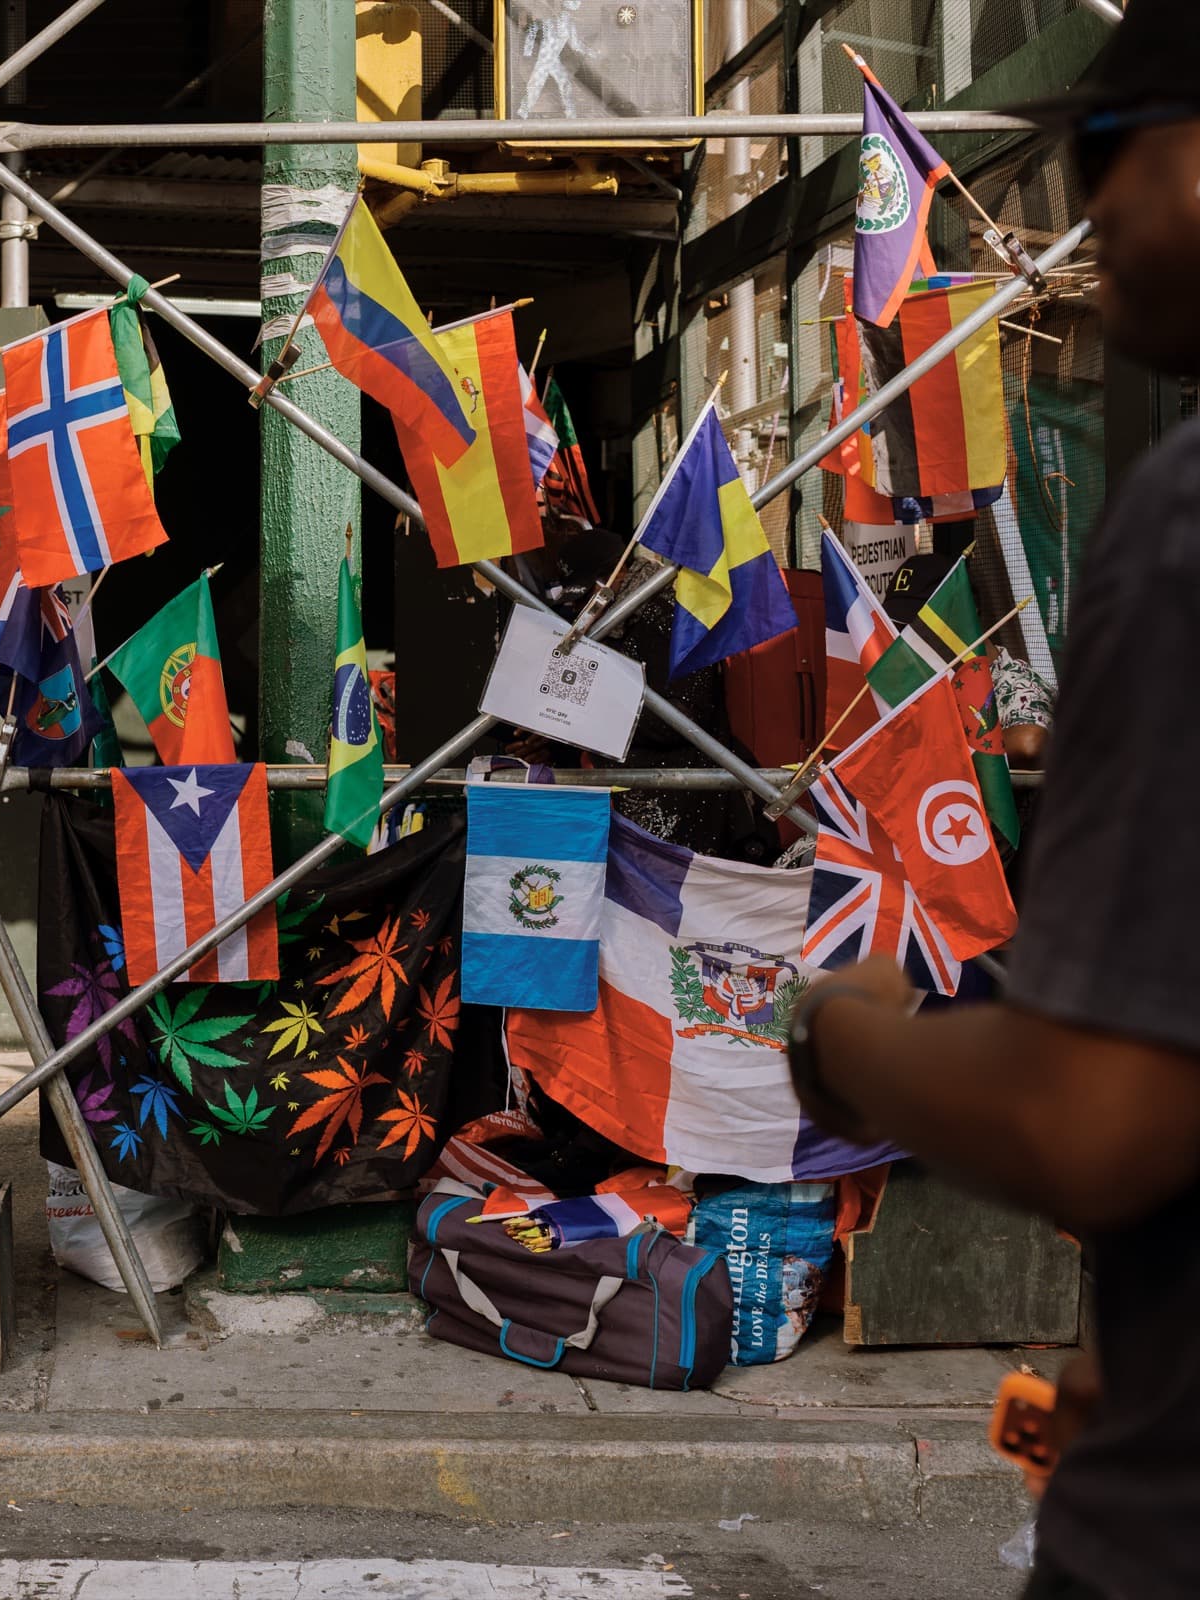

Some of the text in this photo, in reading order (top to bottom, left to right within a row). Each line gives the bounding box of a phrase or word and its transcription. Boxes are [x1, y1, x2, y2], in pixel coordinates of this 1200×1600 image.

[851, 536, 906, 565] PEDESTRIAN
[894, 568, 914, 592] E
[751, 1232, 772, 1348] LOVE the DEALS
